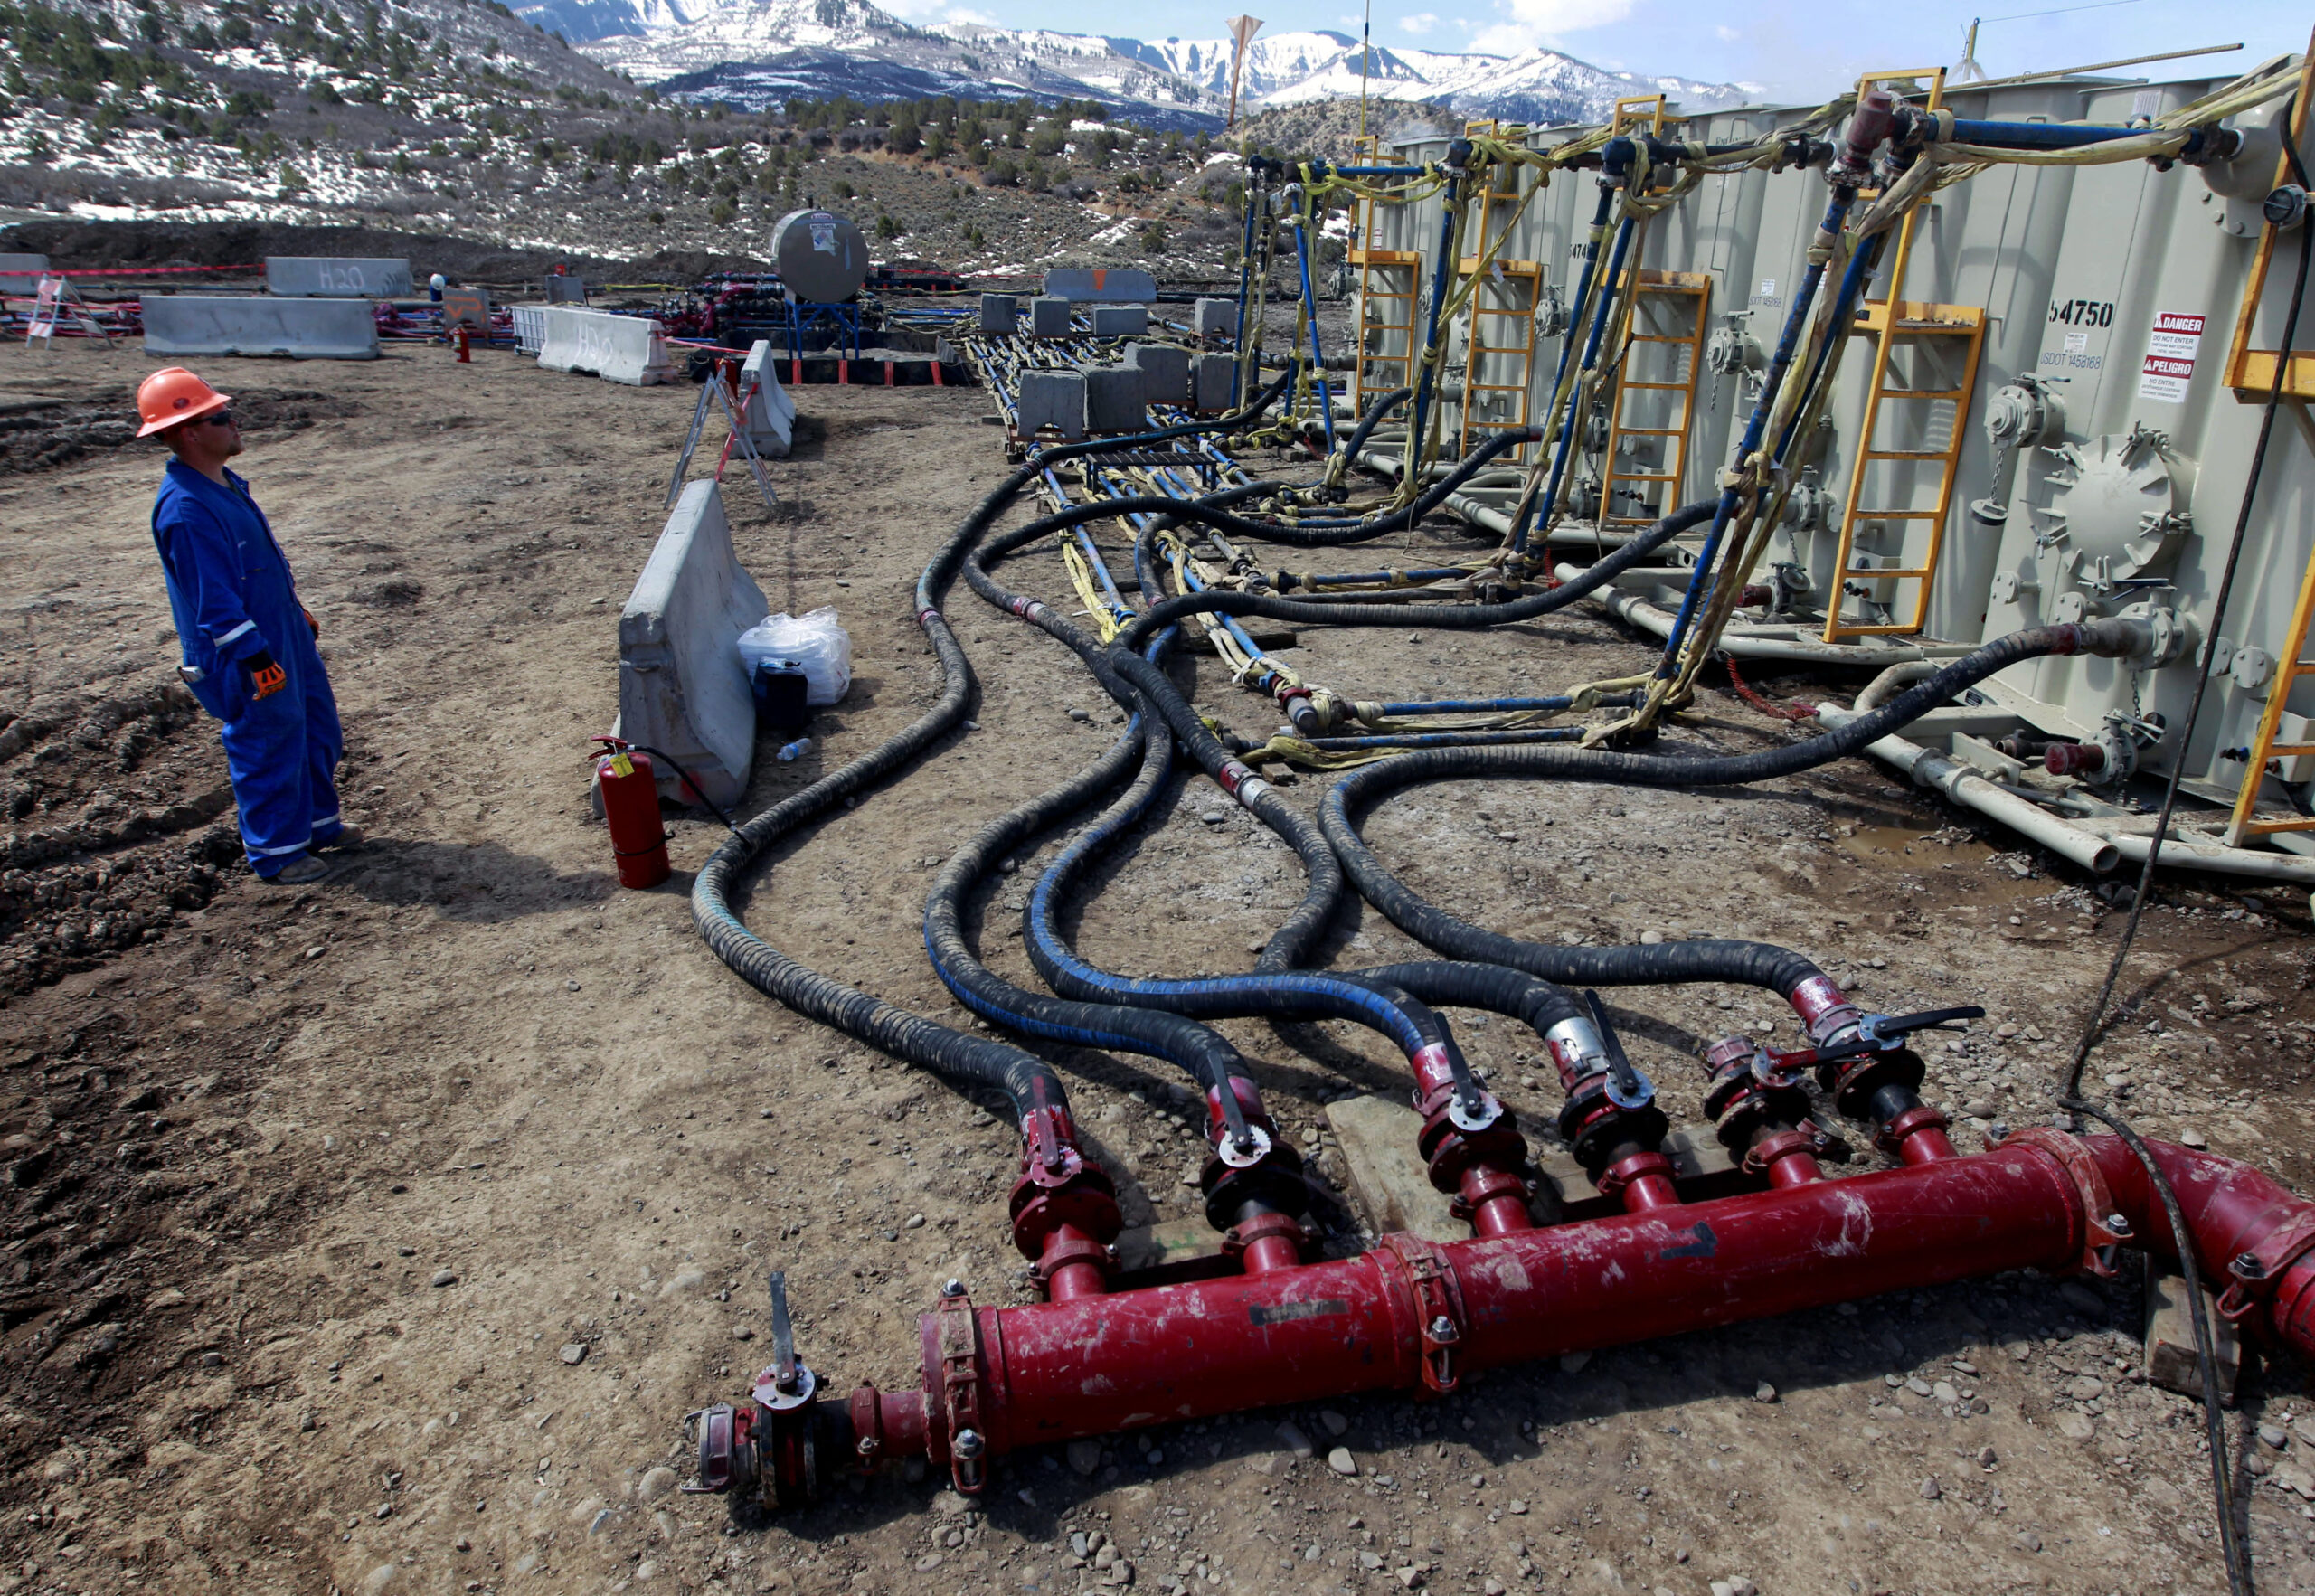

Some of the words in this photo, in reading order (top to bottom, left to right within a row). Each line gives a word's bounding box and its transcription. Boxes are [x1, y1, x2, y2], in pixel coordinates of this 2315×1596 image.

[2163, 316, 2203, 332] DANGER
[2174, 336, 2194, 345] ENTER
[2040, 352, 2066, 366] USDOT
[2069, 355, 2102, 369] 1458168
[2152, 360, 2192, 375] PELIGRO
[2158, 379, 2176, 387] ENTRE
